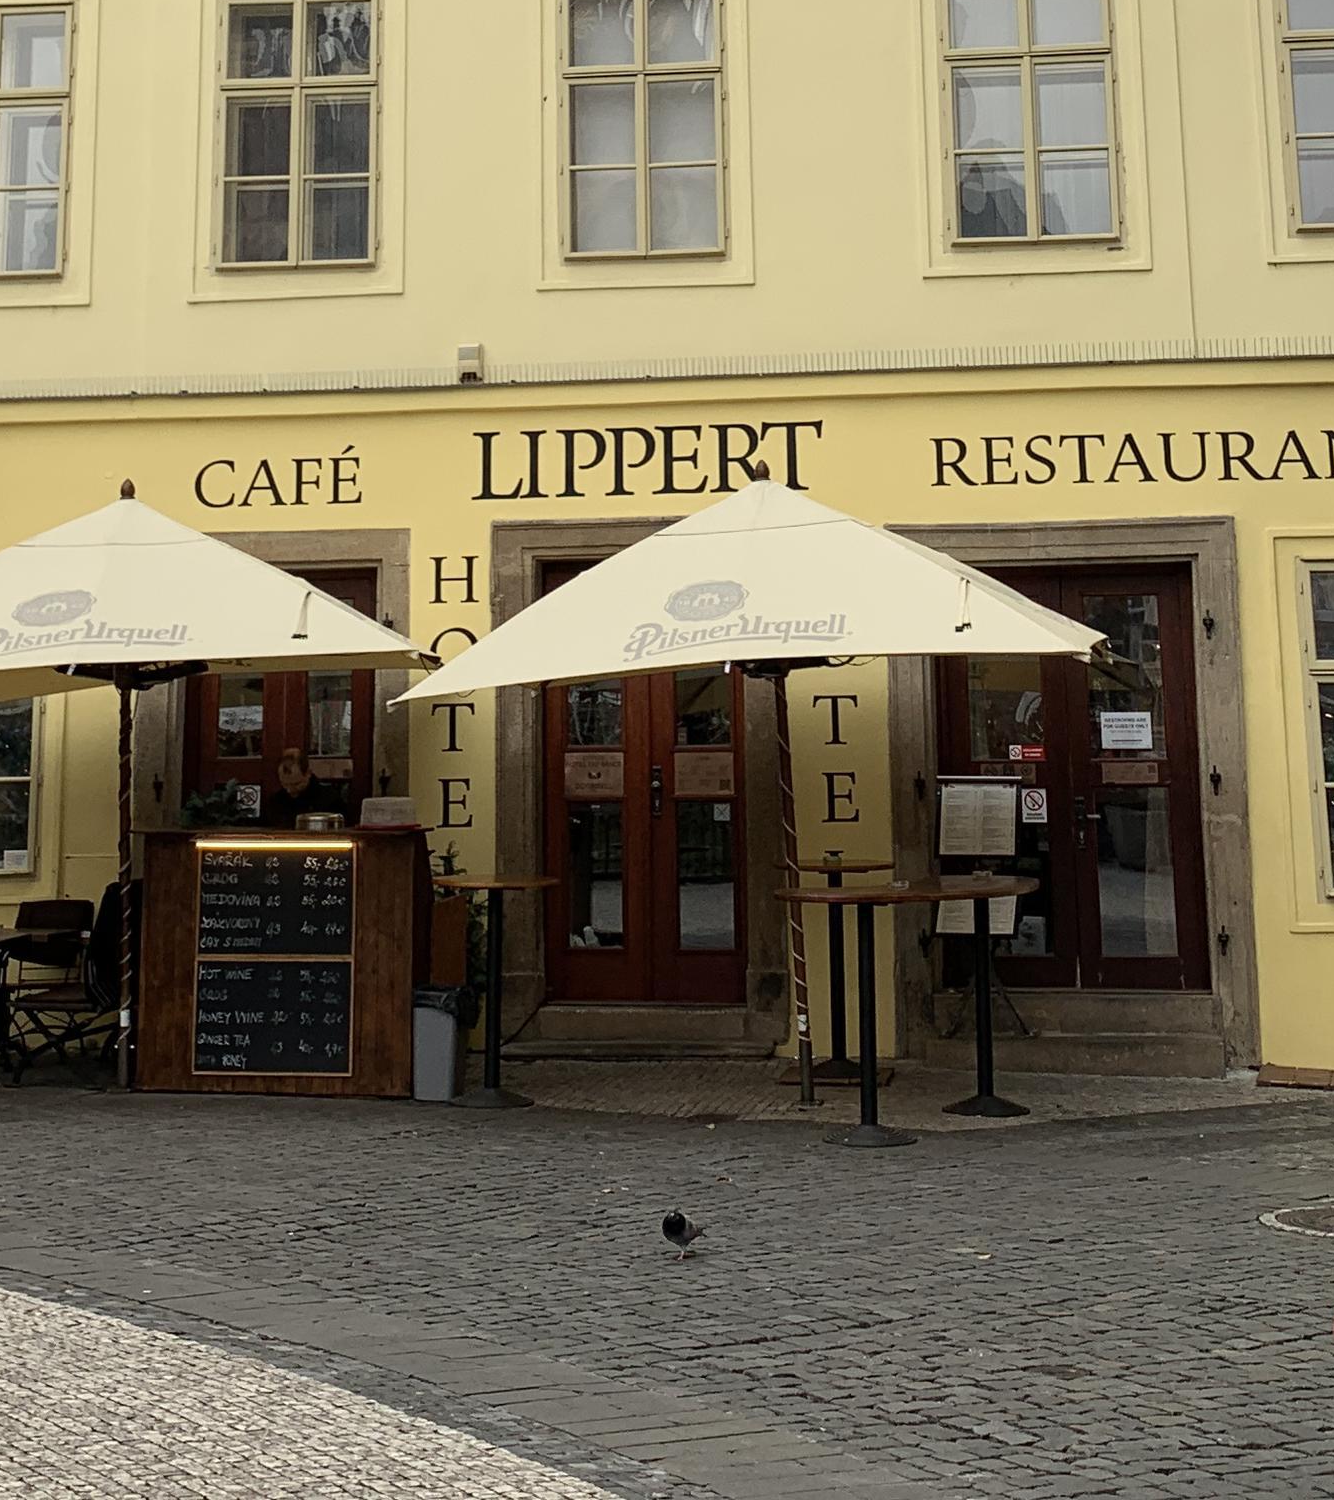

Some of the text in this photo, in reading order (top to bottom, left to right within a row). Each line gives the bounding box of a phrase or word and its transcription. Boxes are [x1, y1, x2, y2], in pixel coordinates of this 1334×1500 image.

[194, 445, 363, 509] CAFÉ
[471, 419, 823, 501] LIPPERT
[82, 619, 188, 647] Urquell
[623, 613, 847, 662] Pilsner Urquell
